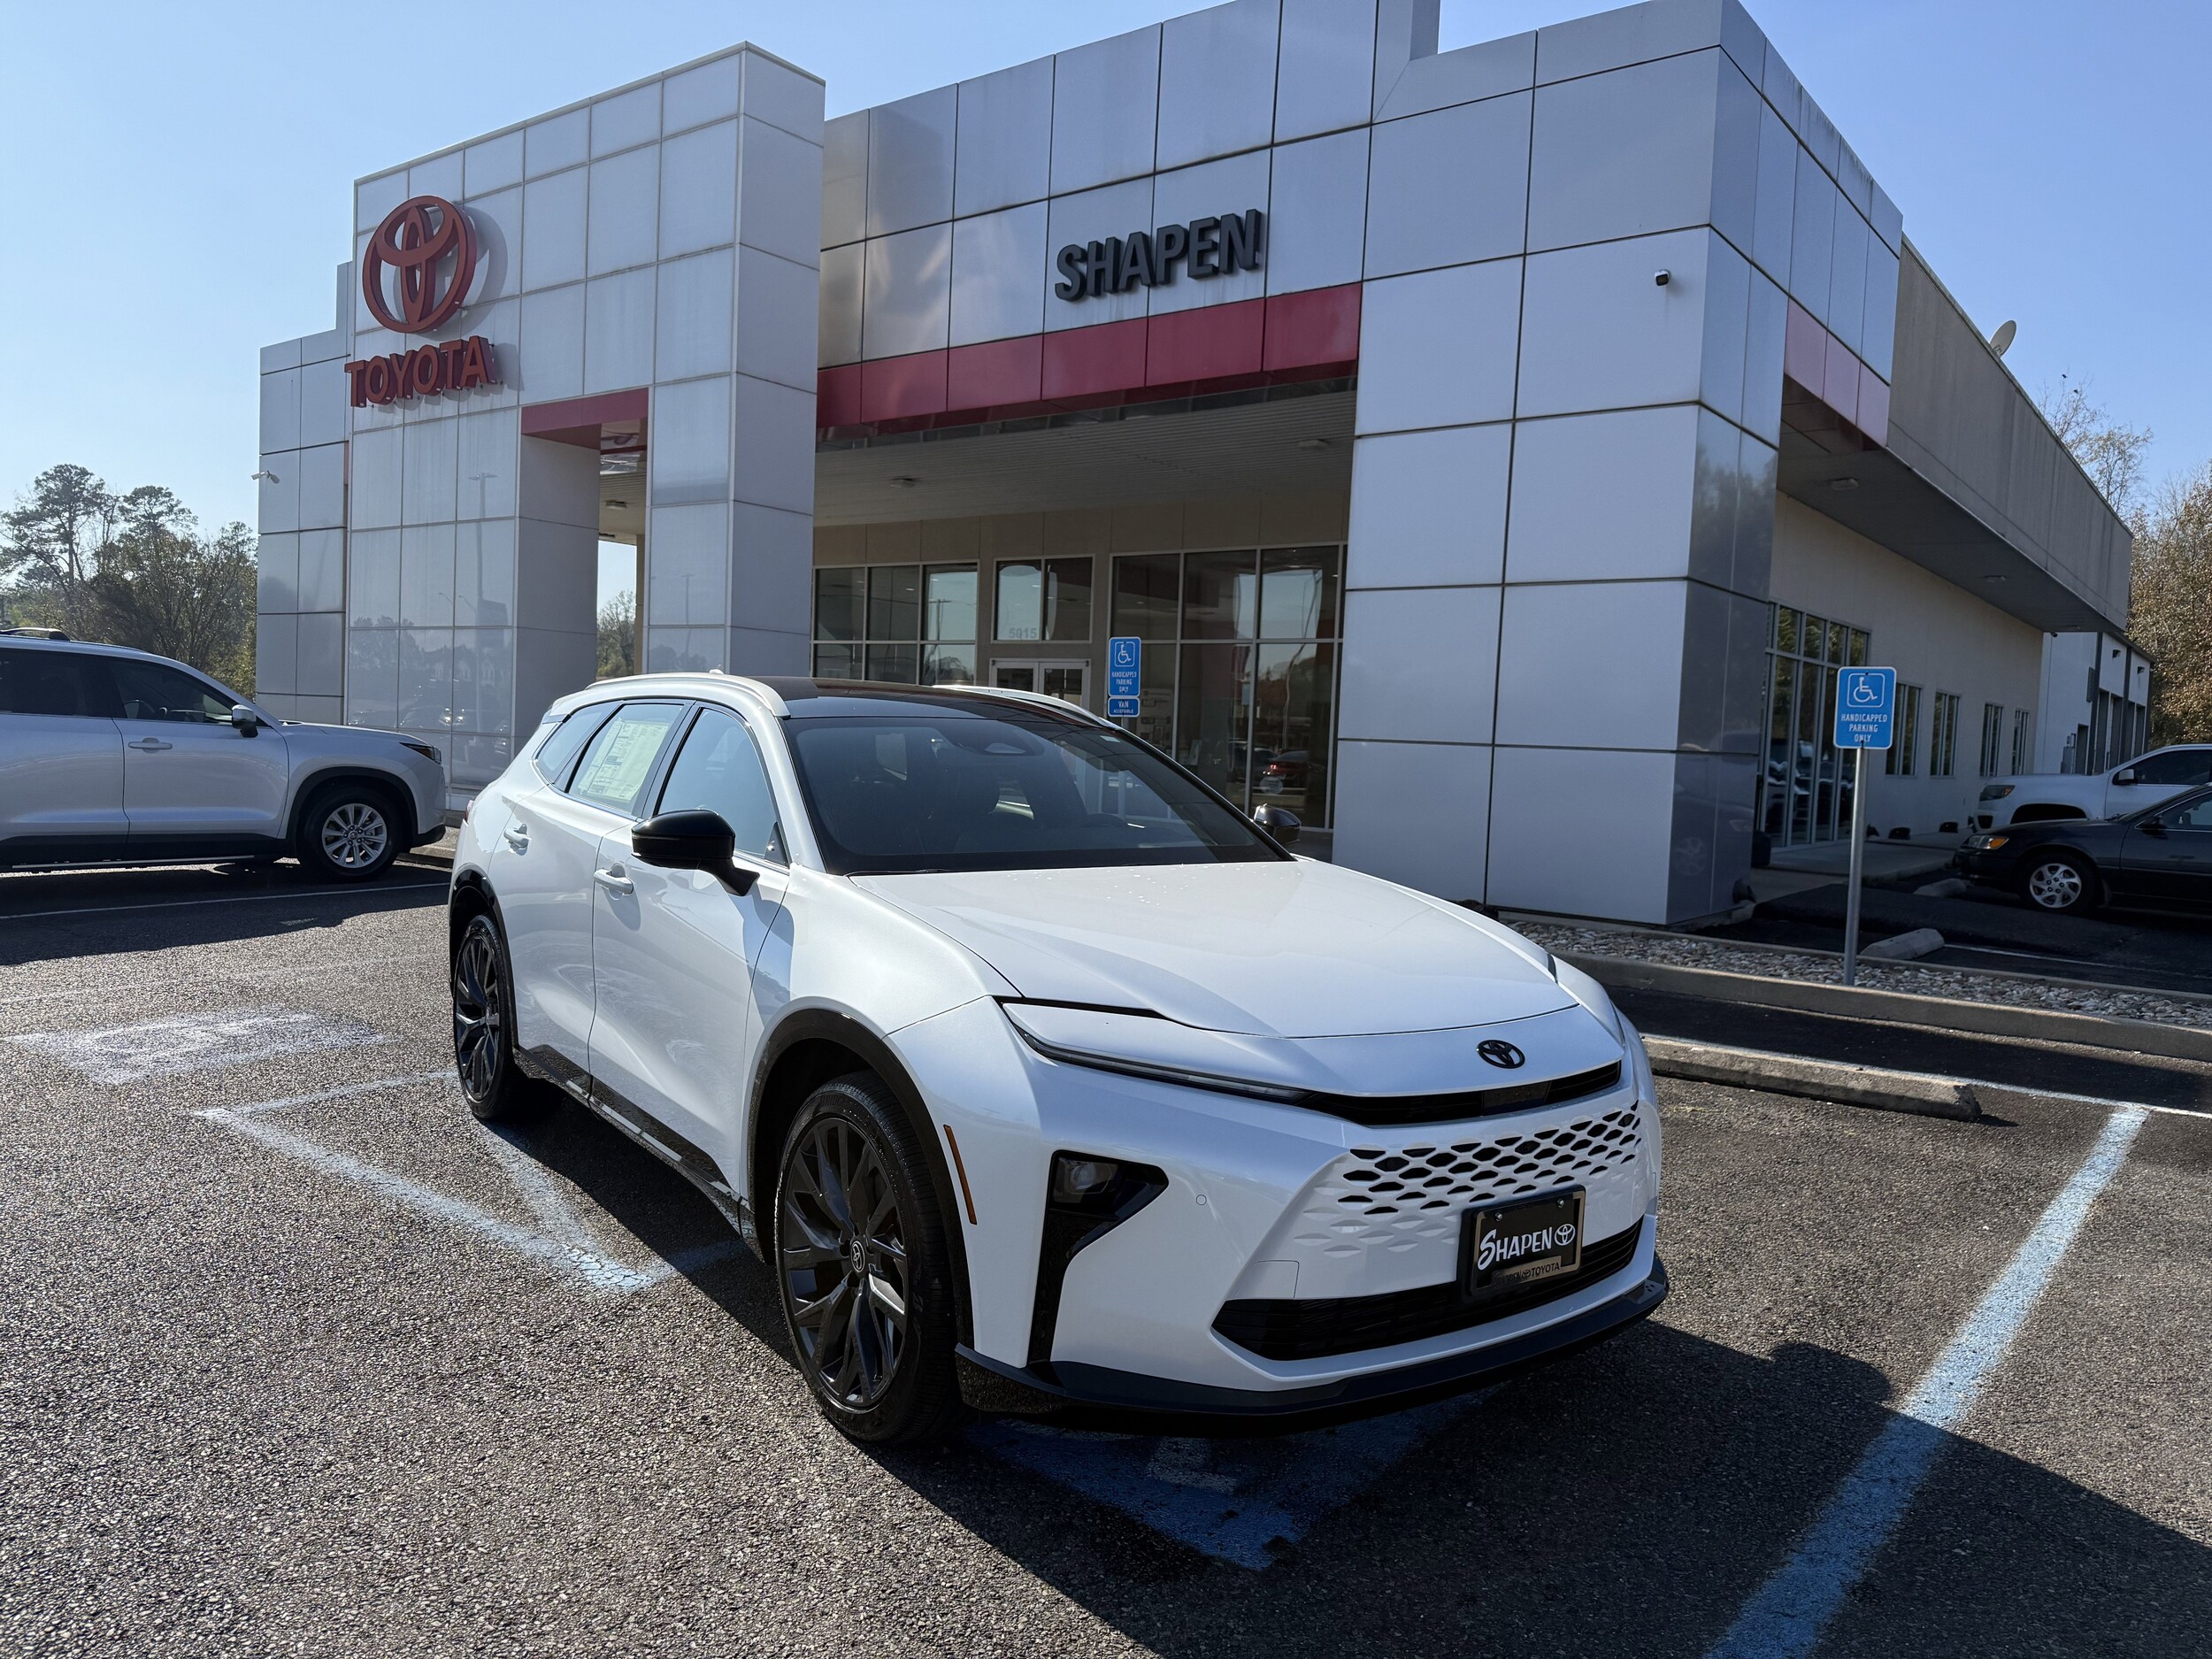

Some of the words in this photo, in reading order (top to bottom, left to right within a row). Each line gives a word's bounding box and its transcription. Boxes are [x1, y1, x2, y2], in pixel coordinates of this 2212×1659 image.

[1055, 209, 1262, 301] SHAPEN
[344, 335, 497, 408] TOYOTA
[1010, 627, 1037, 639] 5015
[1841, 713, 1887, 722] HANDICAPPED
[1848, 724, 1878, 733] PARKING
[1855, 733, 1871, 742] ONLY
[1478, 1228, 1553, 1271] SHAPEN
[1531, 1262, 1560, 1276] TOYOTA
